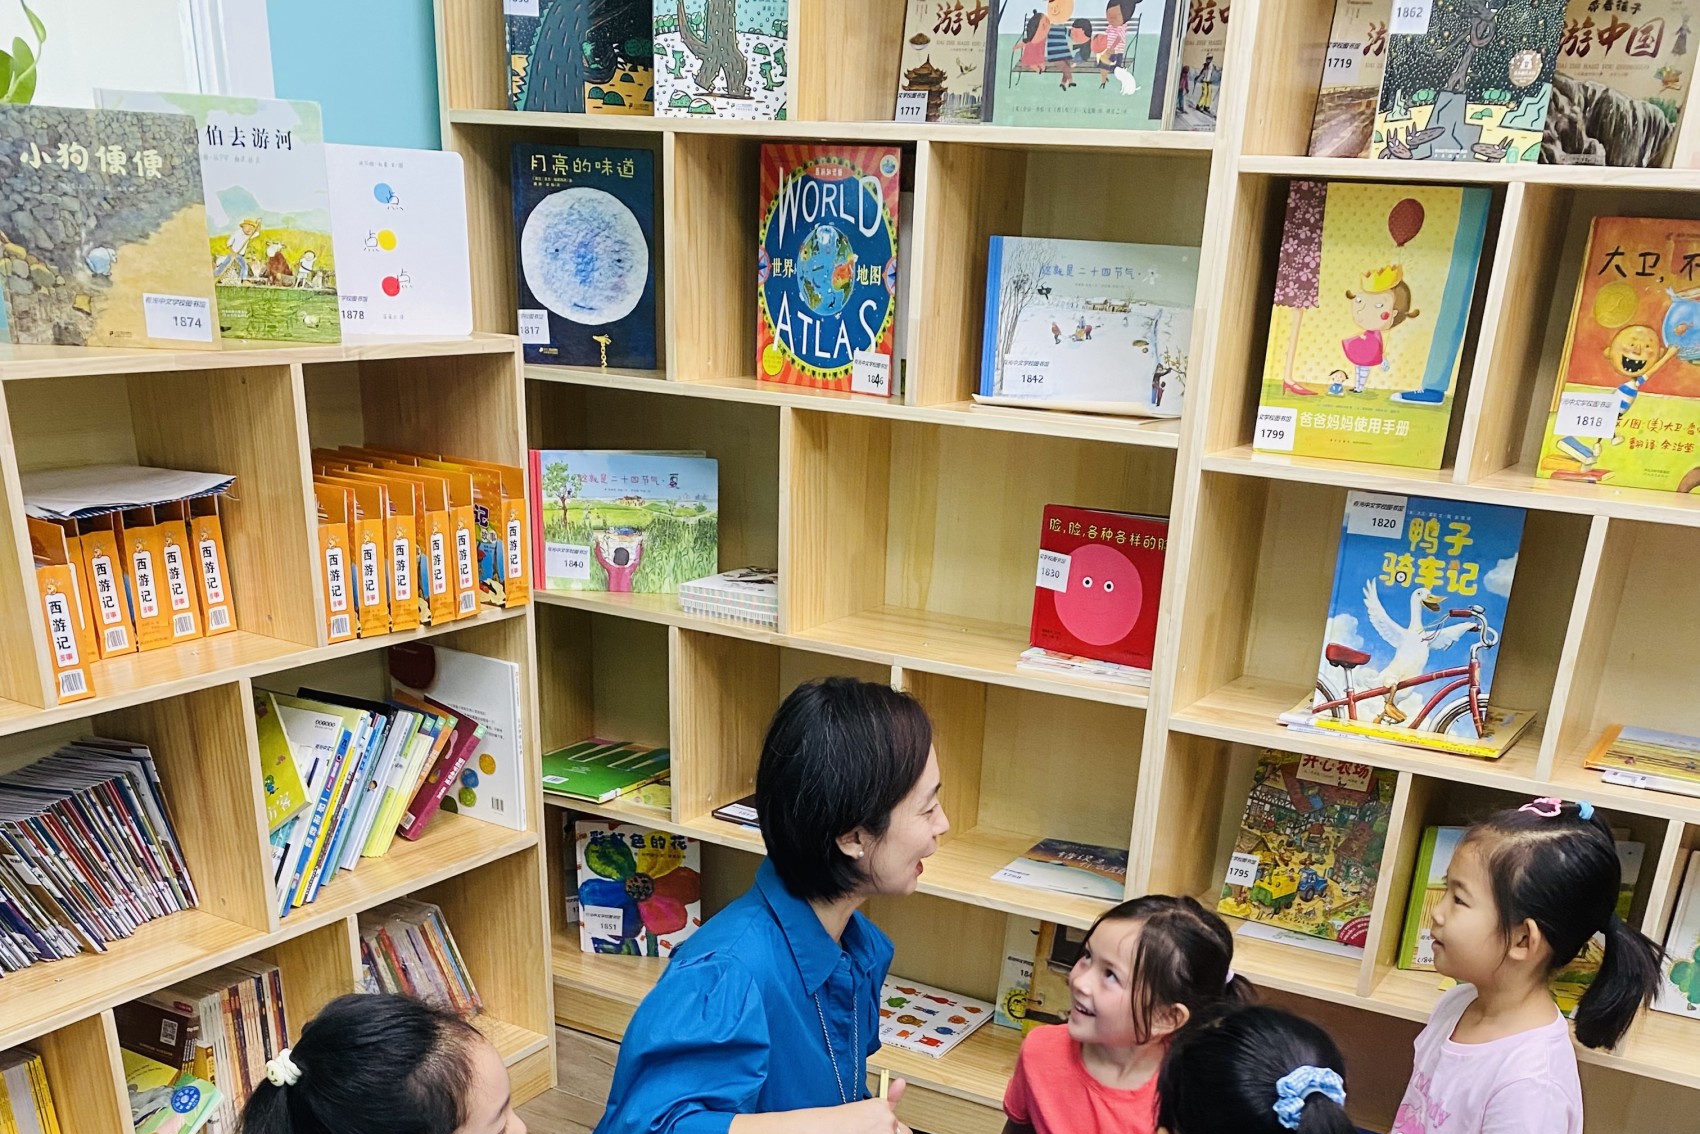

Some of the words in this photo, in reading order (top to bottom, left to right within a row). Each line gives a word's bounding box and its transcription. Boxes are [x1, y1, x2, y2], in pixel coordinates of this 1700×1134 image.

[1397, 7, 1423, 17] 1862
[1328, 58, 1352, 68] 1719
[901, 107, 920, 115] 1717
[196, 125, 291, 150] 伯去游河
[20, 142, 163, 179] 小狗便便
[531, 153, 635, 178] 月亮的味道
[779, 167, 883, 249] WORLD
[771, 258, 795, 278] 世界
[857, 265, 881, 285] 地图
[174, 316, 202, 328] 1874
[341, 310, 365, 319] 1878
[772, 291, 877, 360] ATLAS
[520, 326, 540, 334] 1817
[1021, 374, 1043, 383] 1842
[1300, 412, 1409, 436] 爸爸妈妈使用手册
[1576, 415, 1602, 426] 1818
[1261, 429, 1284, 440] 1799
[1372, 518, 1396, 528] 1820
[509, 526, 519, 566] 西游记
[1408, 518, 1473, 556] 鸭子
[395, 544, 407, 586] 西游记
[432, 539, 443, 581] 西游记
[458, 535, 469, 575] 西游记
[564, 560, 584, 568] 1840
[166, 551, 183, 596] 西游记
[202, 546, 218, 589] 西游记
[328, 553, 342, 597] 西游记
[363, 549, 375, 591] 西游记
[1379, 552, 1480, 596] 骑车记
[95, 562, 115, 609] 西游记
[136, 558, 152, 603] 西游记
[48, 600, 71, 650] 西游记
[1303, 755, 1369, 779] 开心农场
[590, 831, 687, 850] 彩虹色的花
[1229, 867, 1249, 878] 1795
[600, 922, 617, 931] 1851
